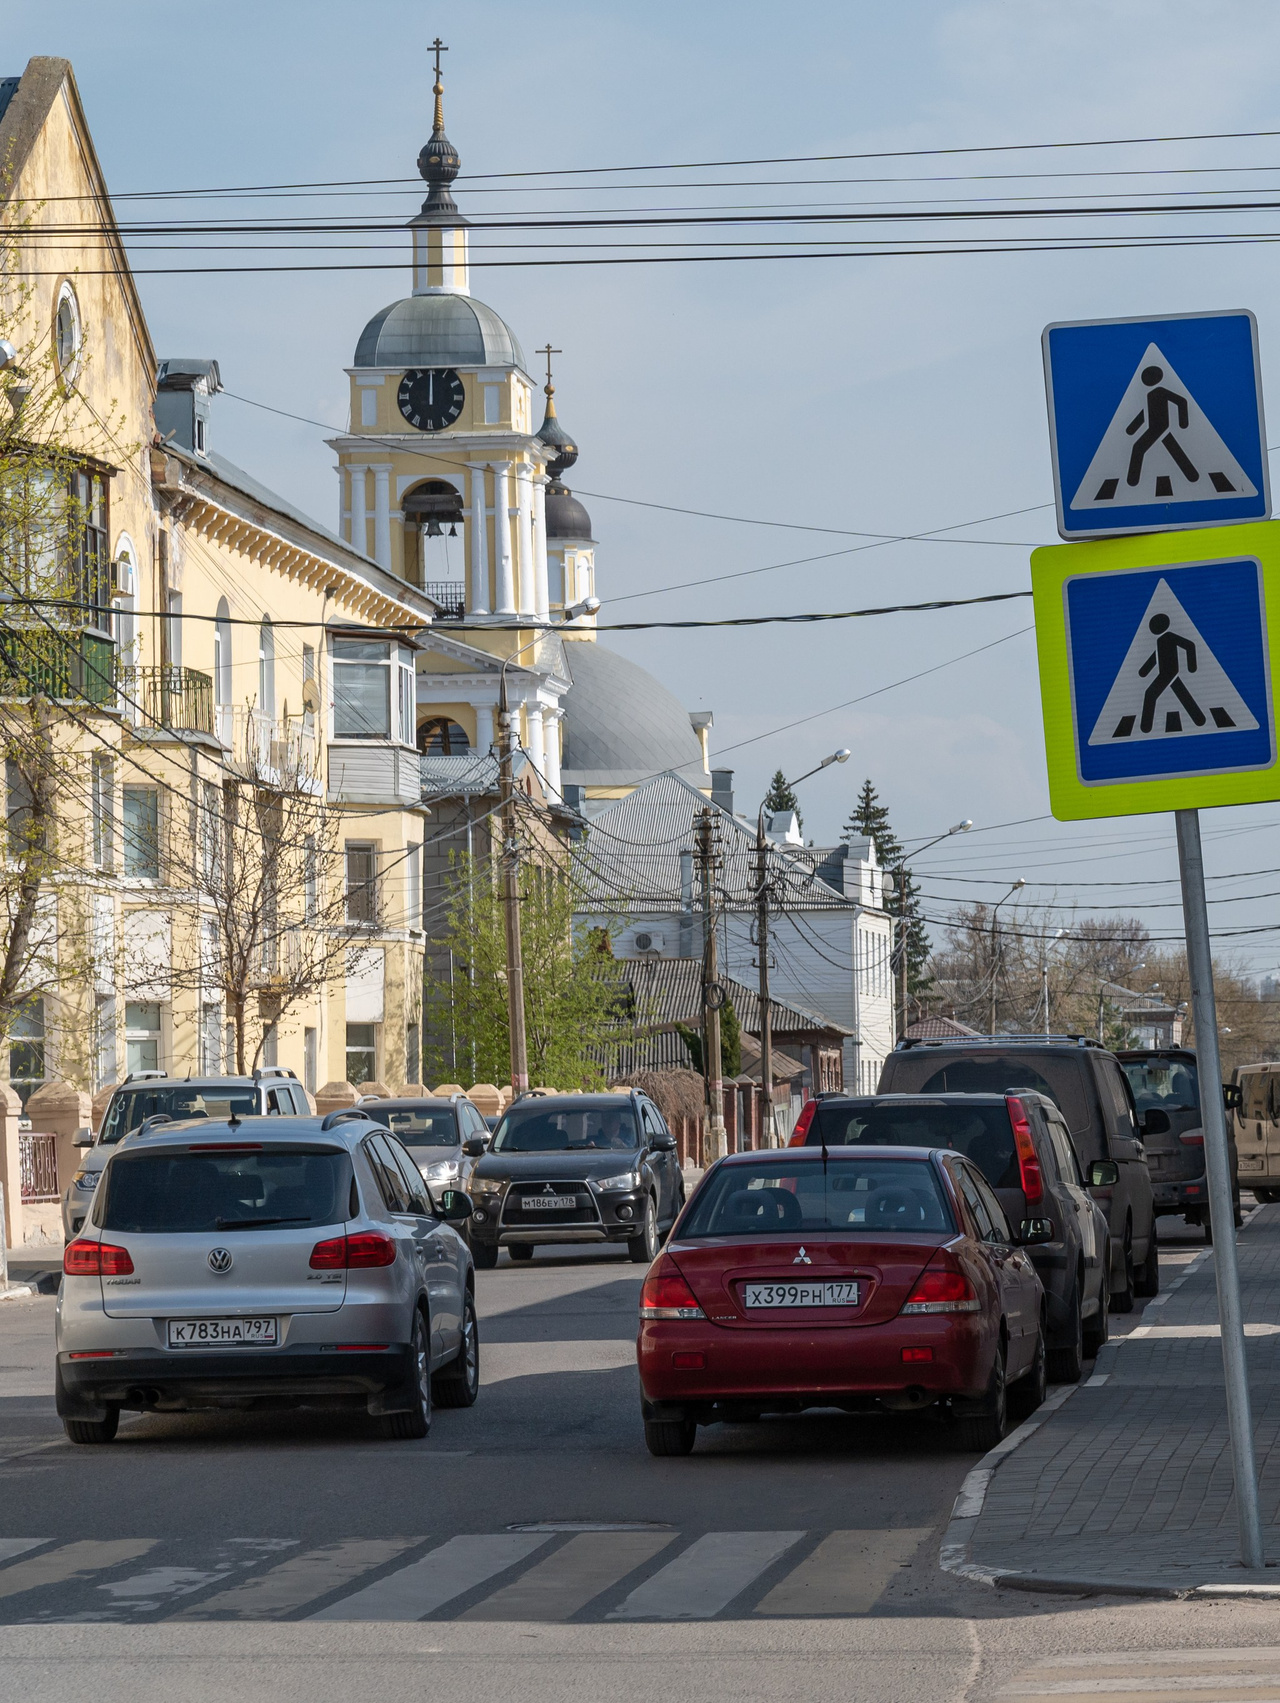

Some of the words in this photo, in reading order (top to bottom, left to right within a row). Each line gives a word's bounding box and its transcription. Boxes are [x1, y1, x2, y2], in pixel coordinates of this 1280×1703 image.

[752, 1286, 822, 1304] Х399РН
[826, 1284, 854, 1298] 177
[176, 1322, 242, 1340] К783НА
[245, 1321, 271, 1334] 797
